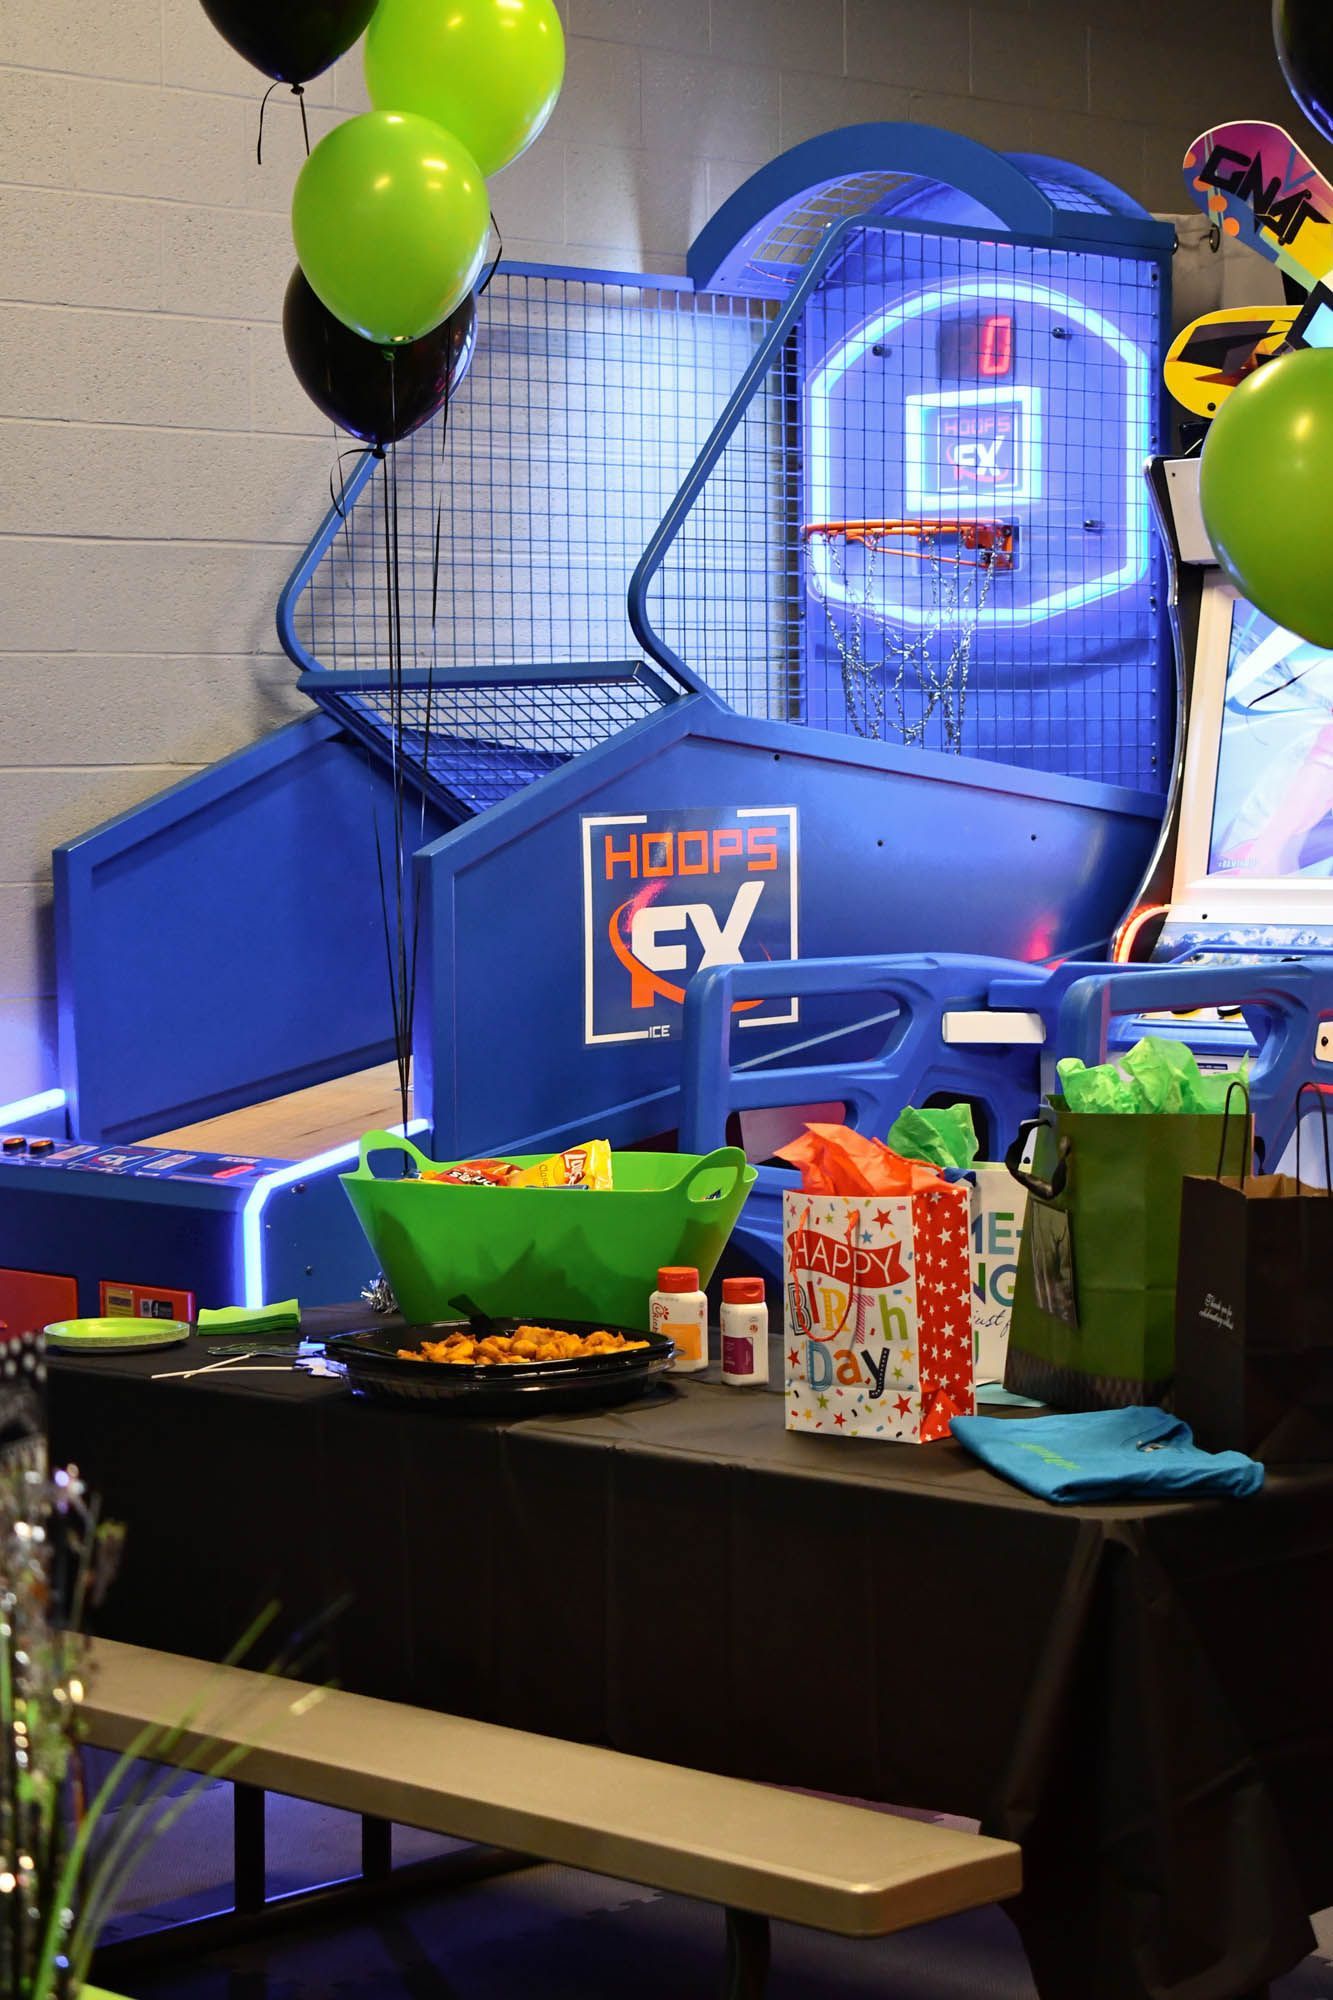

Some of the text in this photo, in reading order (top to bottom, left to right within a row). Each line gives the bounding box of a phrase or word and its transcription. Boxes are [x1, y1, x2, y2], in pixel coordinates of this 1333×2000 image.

[979, 316, 1012, 376] 0
[944, 416, 1011, 435] HOOPS
[604, 827, 778, 880] HOOPS
[649, 1025, 670, 1038] ICE
[793, 1232, 894, 1284] HAPPY
[973, 1309, 1005, 1327] ust
